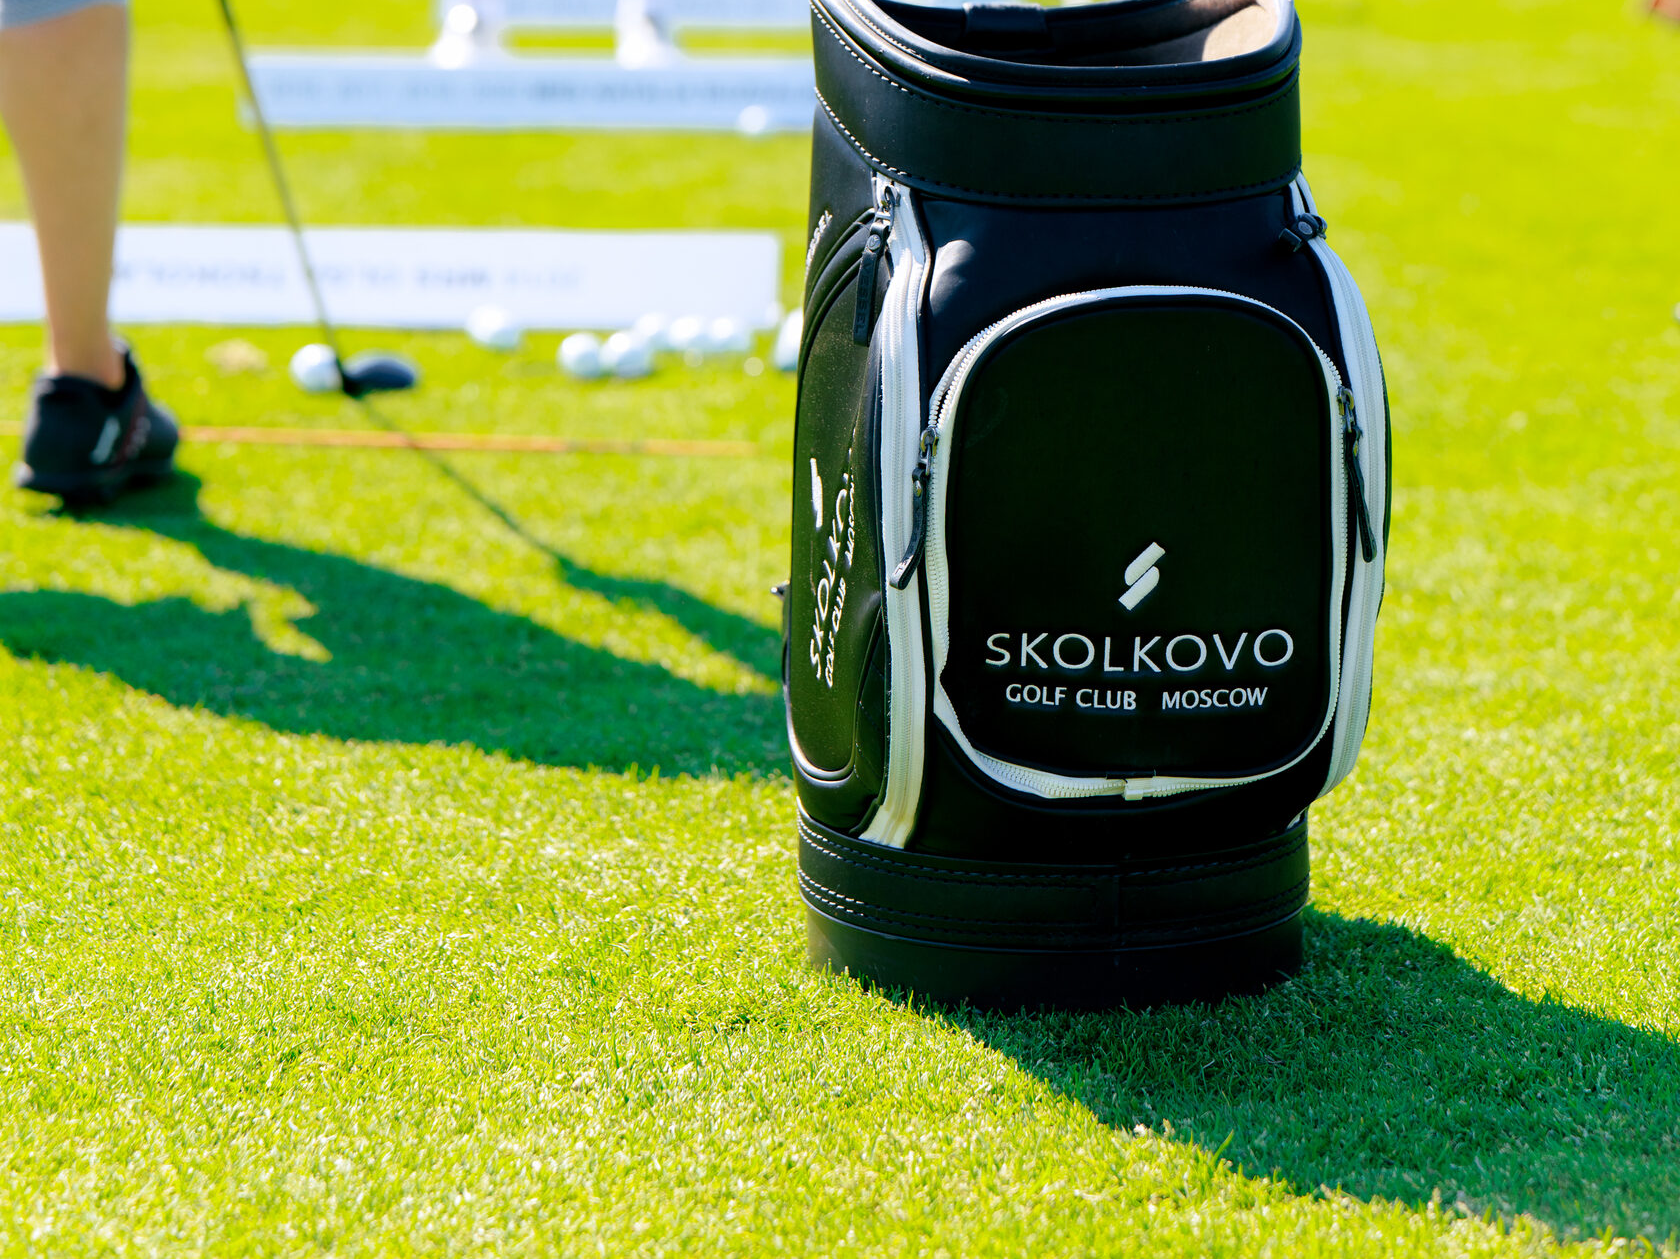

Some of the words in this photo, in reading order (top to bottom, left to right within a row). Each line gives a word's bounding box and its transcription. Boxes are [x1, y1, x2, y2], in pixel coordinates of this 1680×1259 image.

[985, 628, 1295, 673] SKOLKOVO
[1005, 683, 1067, 706] GOLF
[1075, 688, 1137, 711] CLUB
[1162, 686, 1268, 710] MOSCOW
